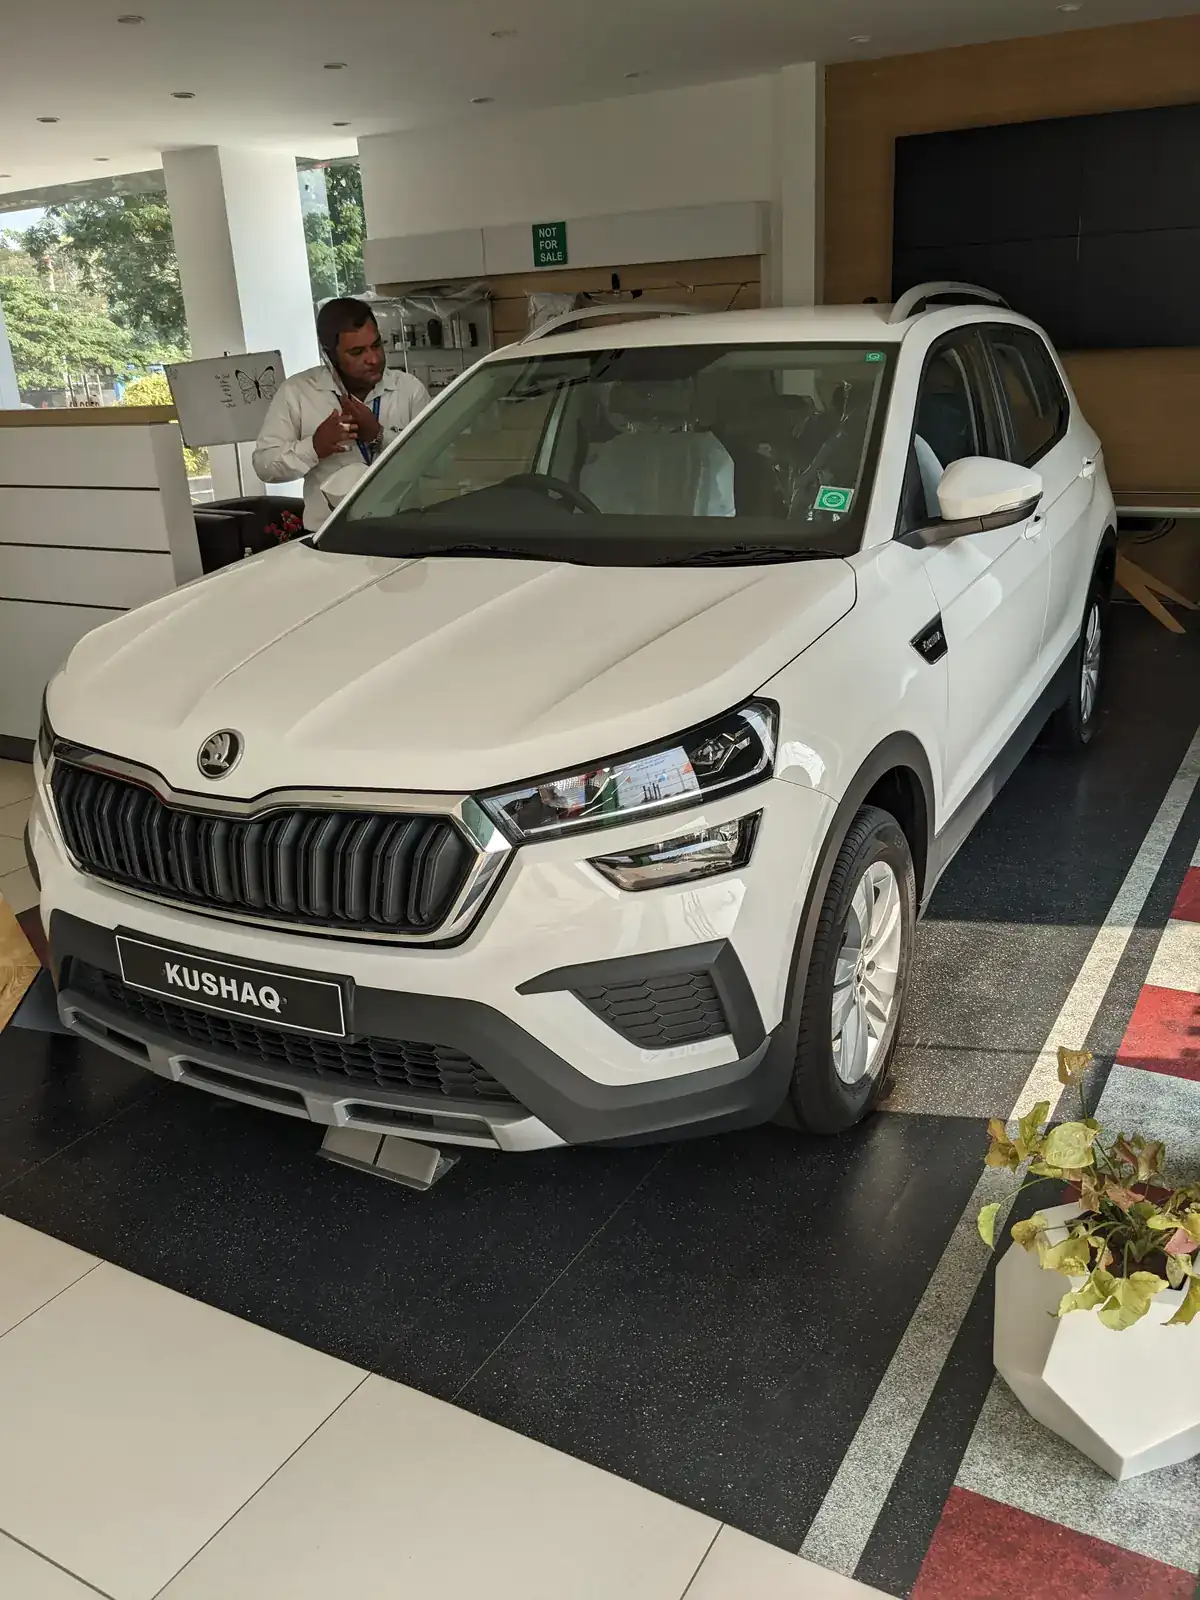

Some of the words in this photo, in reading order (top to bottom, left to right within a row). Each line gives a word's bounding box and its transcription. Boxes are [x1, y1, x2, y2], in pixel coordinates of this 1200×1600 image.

[538, 227, 557, 238] NOT
[539, 240, 558, 250] FOR
[540, 251, 563, 262] SALE
[164, 961, 281, 1014] KUSHAQ
